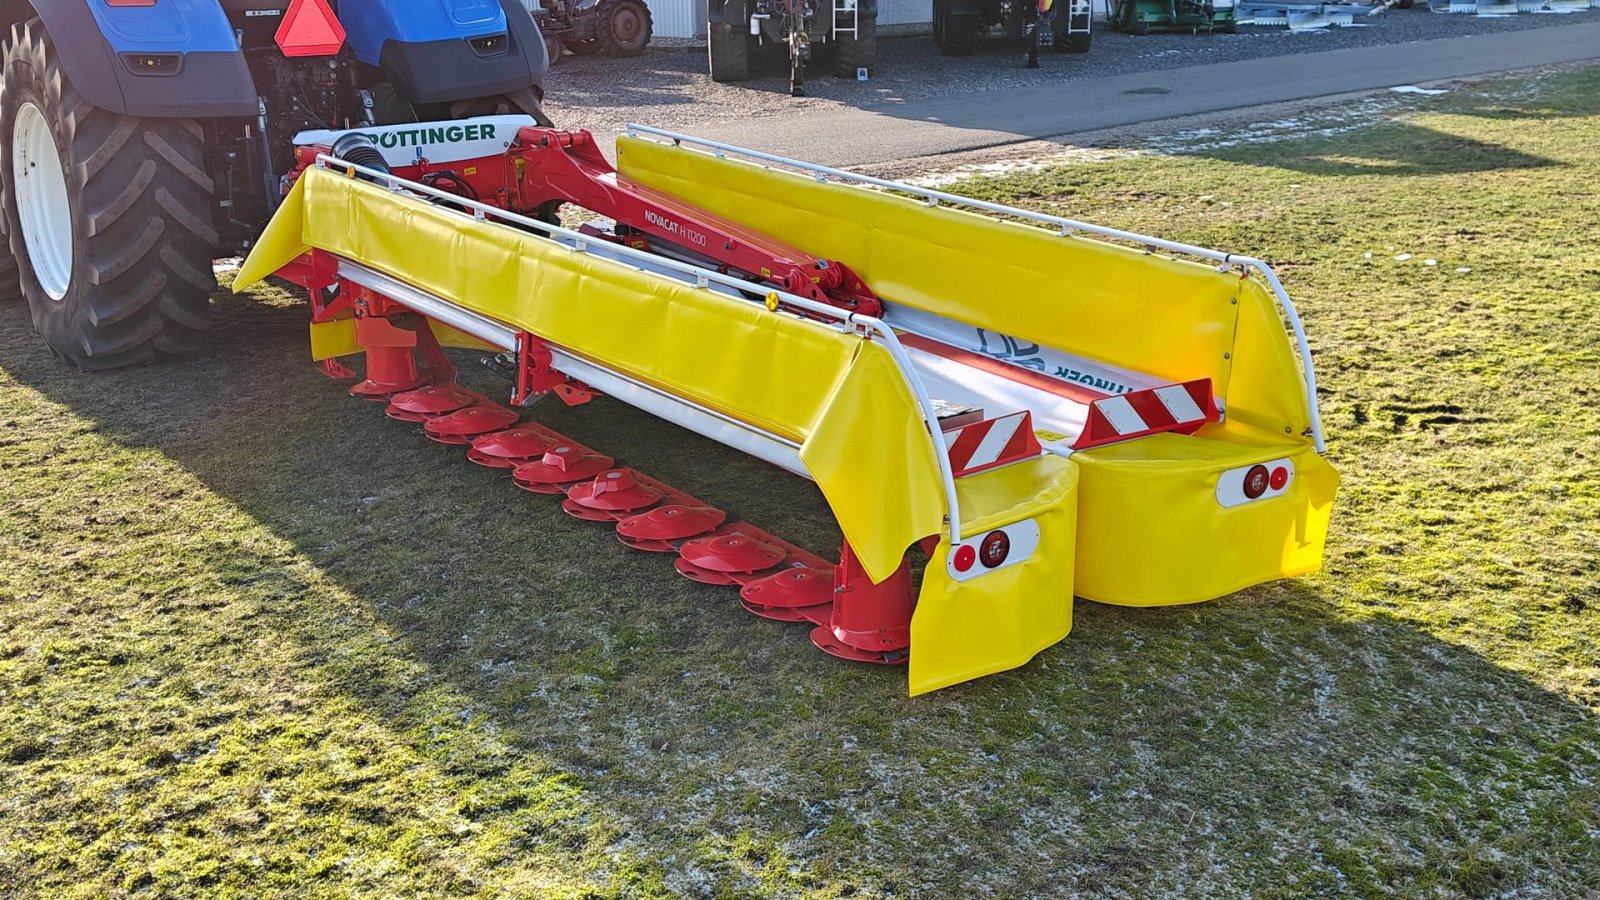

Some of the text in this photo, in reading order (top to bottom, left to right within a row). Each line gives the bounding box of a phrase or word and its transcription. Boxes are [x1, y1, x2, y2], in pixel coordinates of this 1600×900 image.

[644, 209, 707, 247] NOVACAT H 11200
